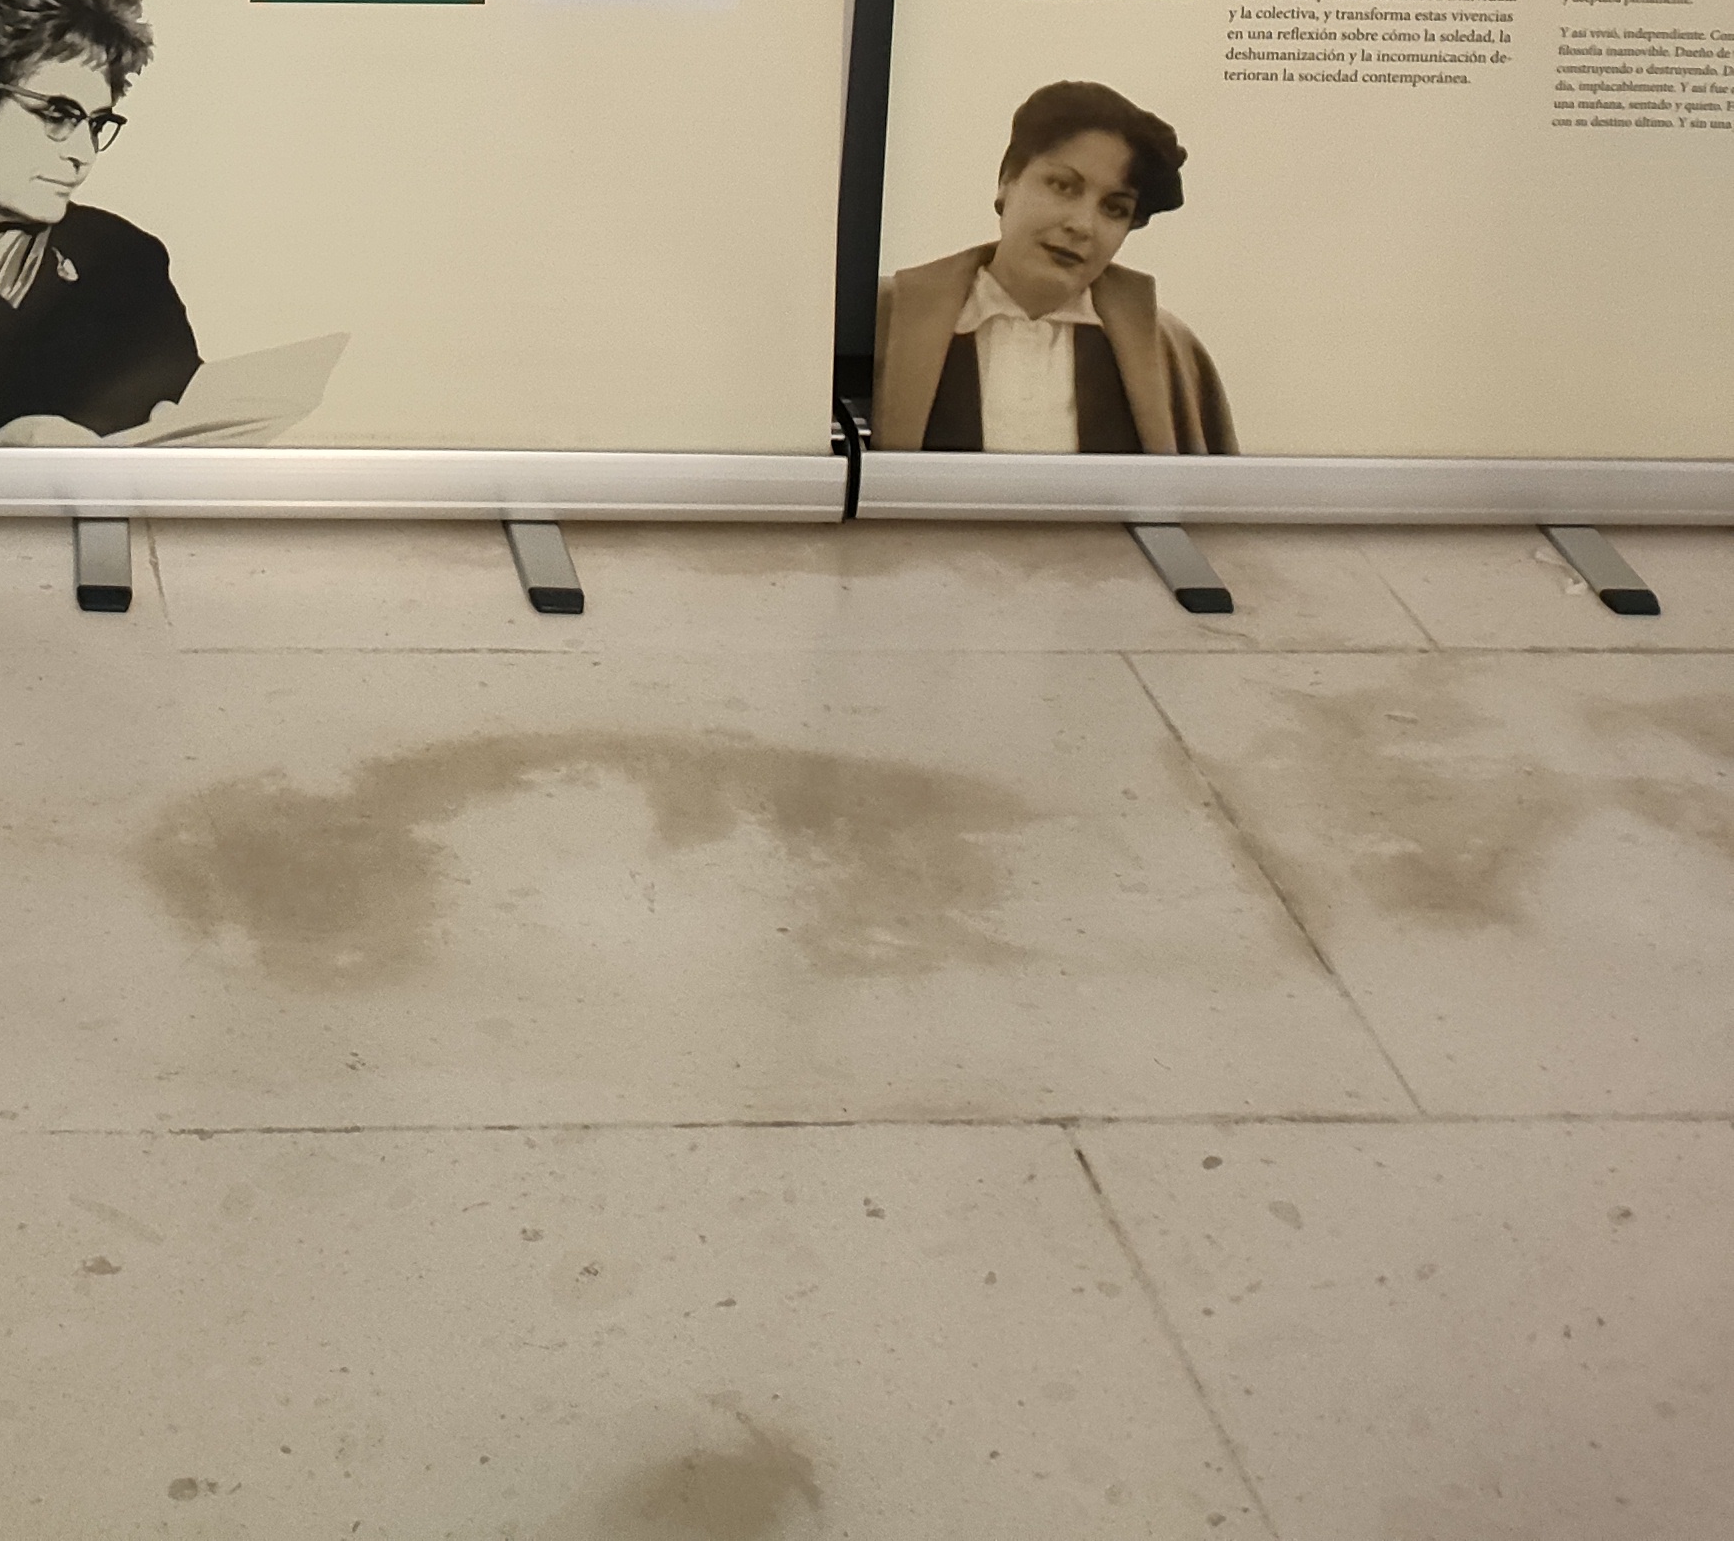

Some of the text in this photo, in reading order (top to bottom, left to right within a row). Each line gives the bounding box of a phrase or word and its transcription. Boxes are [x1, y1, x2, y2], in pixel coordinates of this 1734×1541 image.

[1223, 67, 1472, 88] terioran la sociedad contemporánea.
